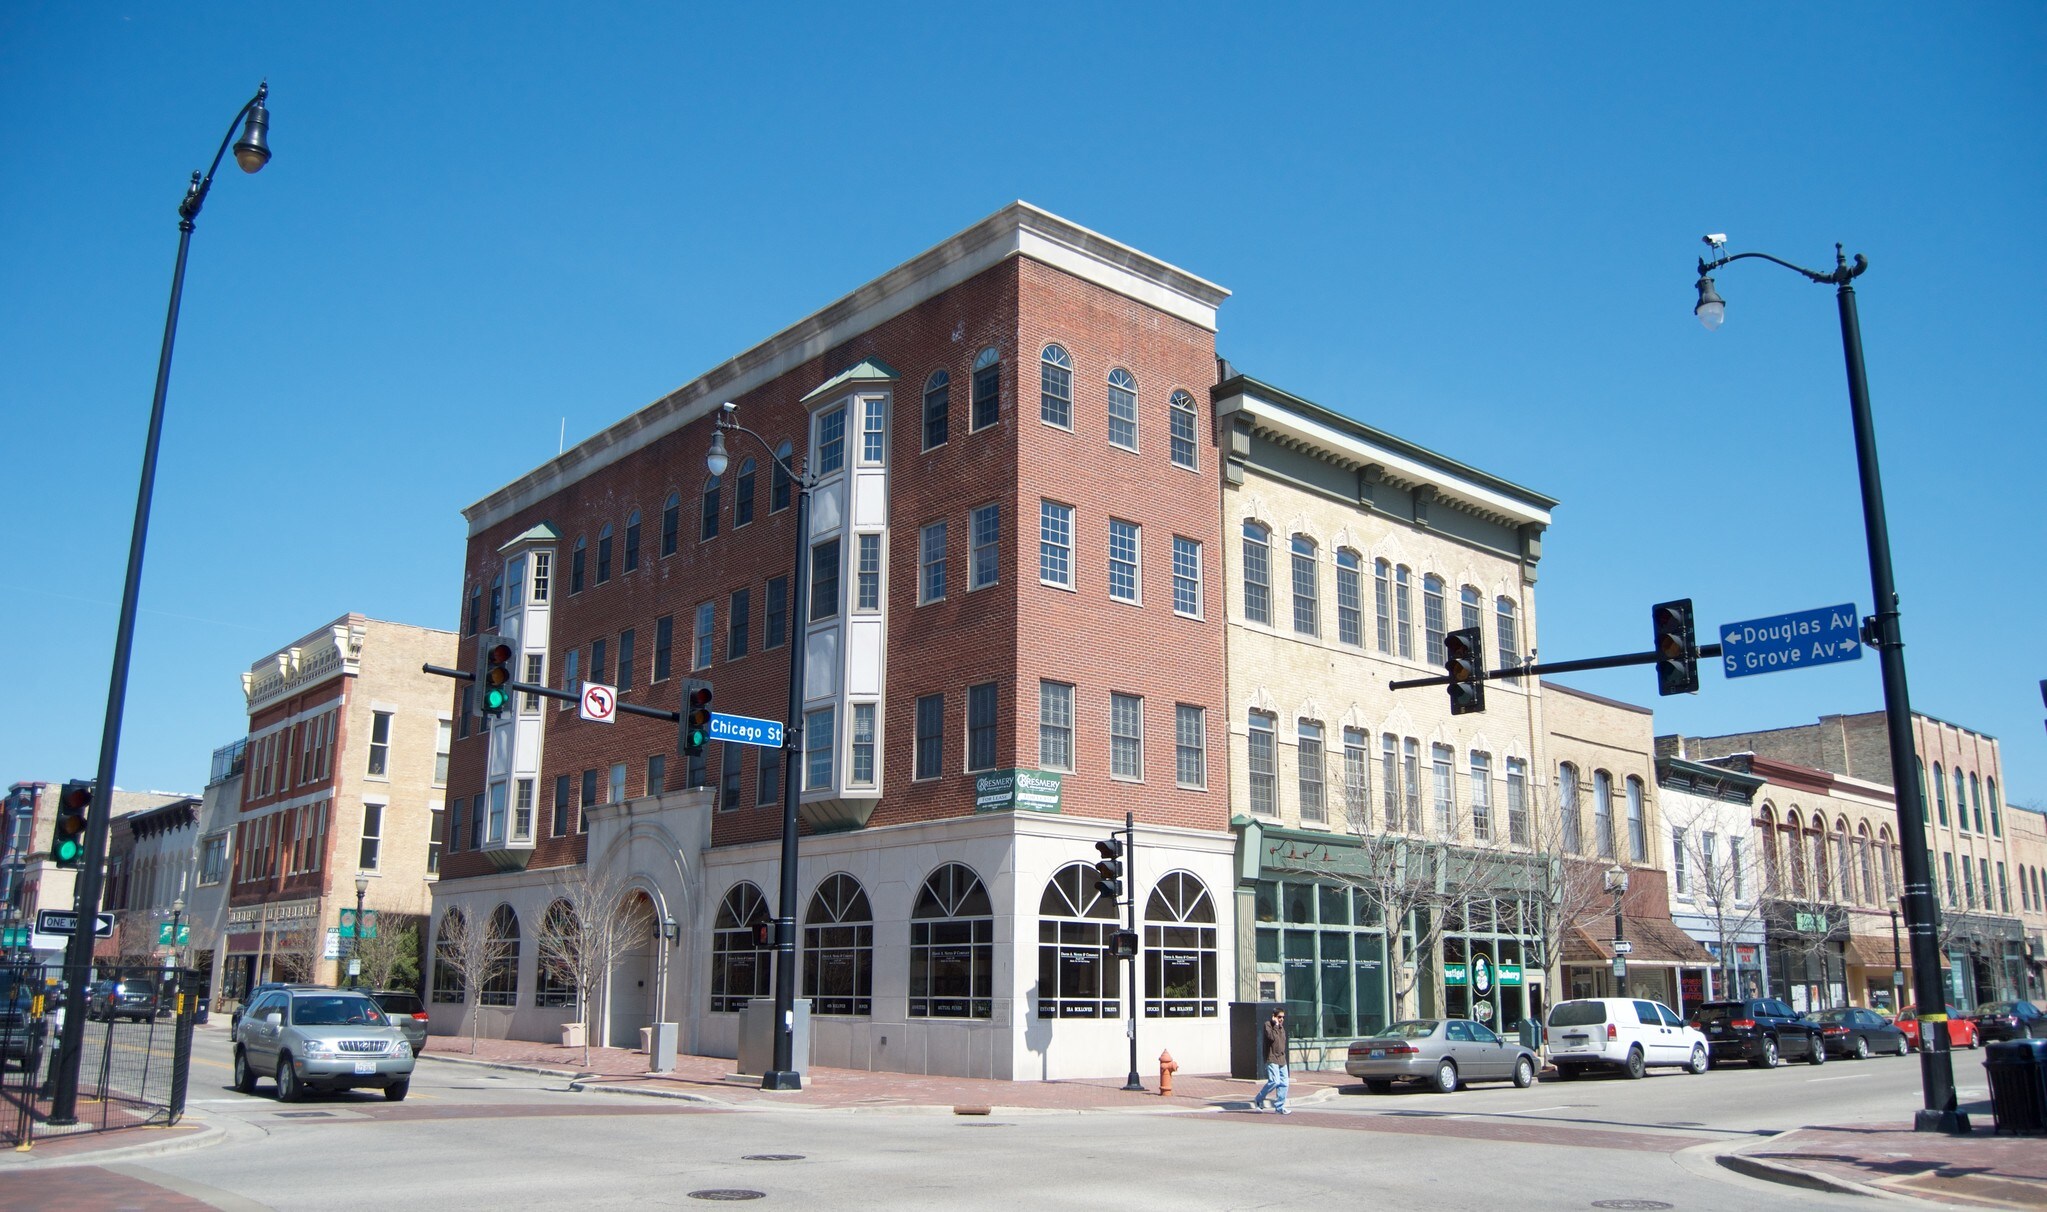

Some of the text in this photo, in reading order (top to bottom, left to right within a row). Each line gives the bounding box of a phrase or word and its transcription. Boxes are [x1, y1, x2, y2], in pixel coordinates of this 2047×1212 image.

[1744, 613, 1853, 644] Douglas Av
[1726, 641, 1835, 672] S Grove Av
[711, 719, 781, 741] Chicago St
[46, 917, 67, 927] ONE
[1498, 969, 1520, 981] Bakery
